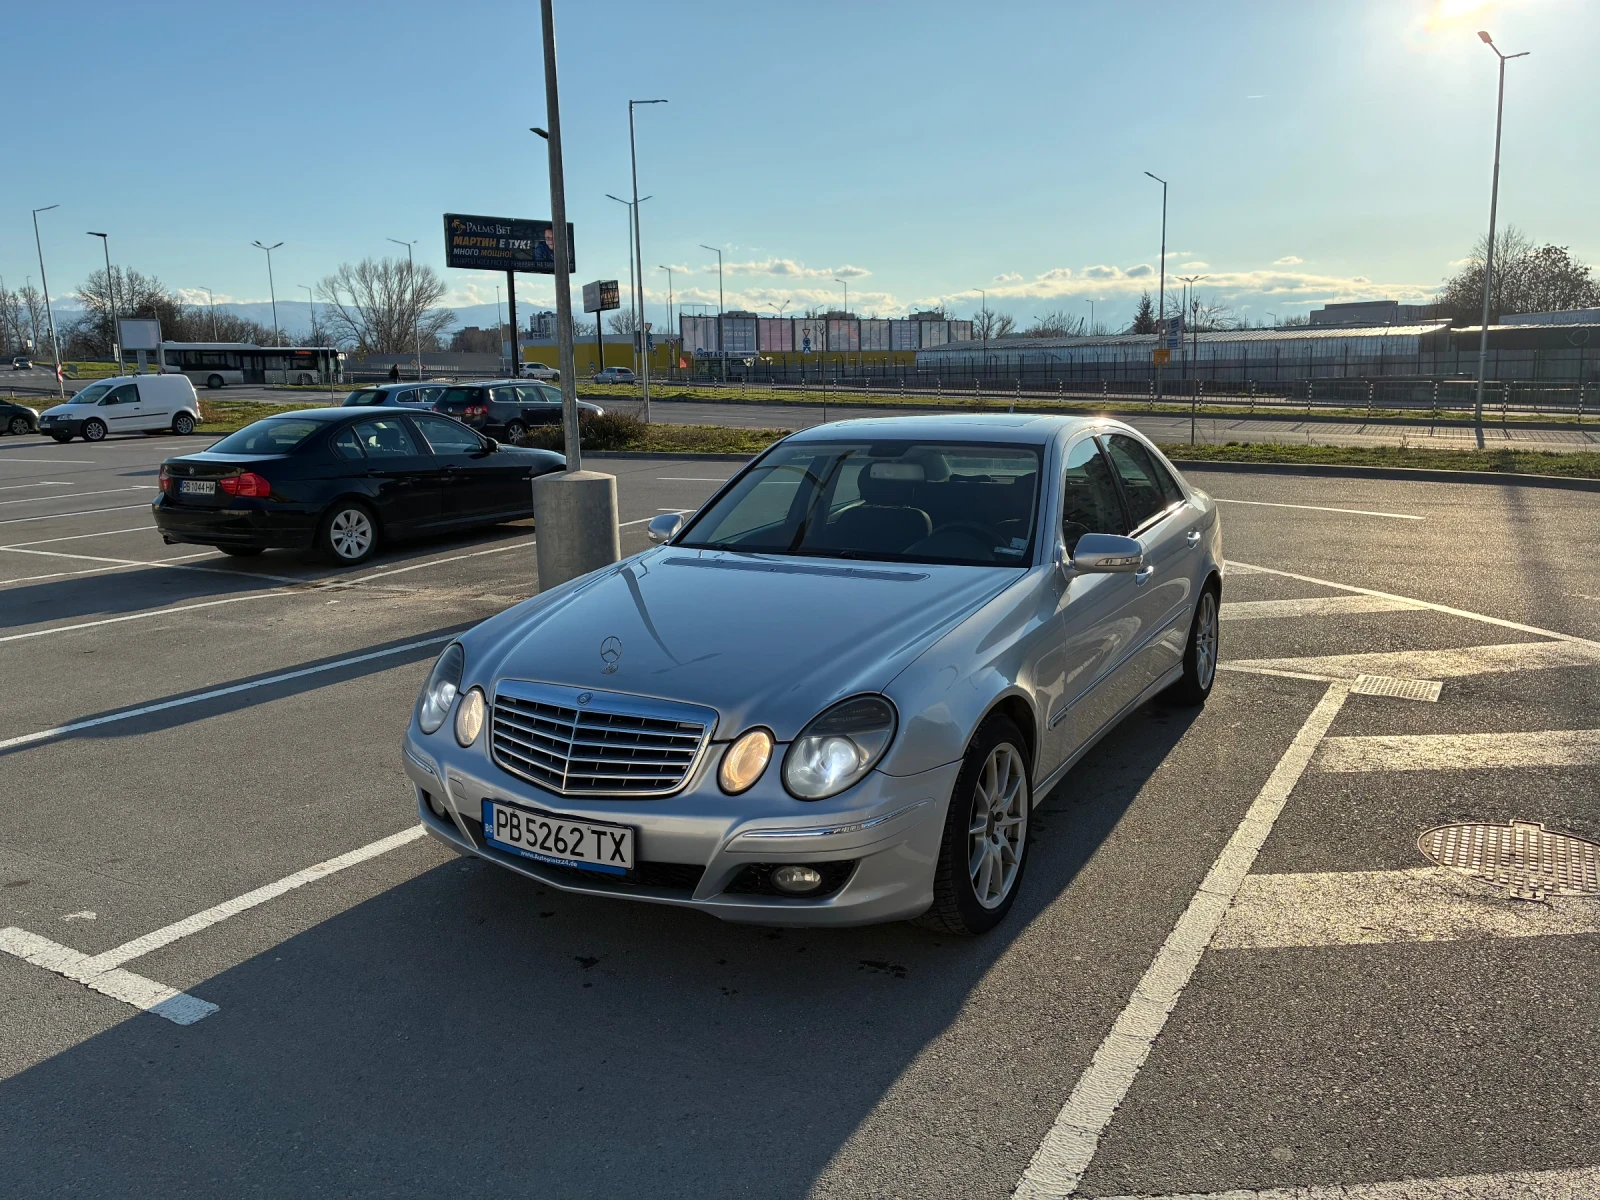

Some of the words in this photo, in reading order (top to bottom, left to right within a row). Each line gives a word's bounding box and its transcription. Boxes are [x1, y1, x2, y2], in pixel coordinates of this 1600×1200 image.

[453, 235, 497, 247] МАРТИН
[509, 239, 531, 249] ТУК!
[453, 248, 479, 256] МНОГО
[481, 249, 512, 258] МОЩНО!
[484, 823, 494, 834] BG
